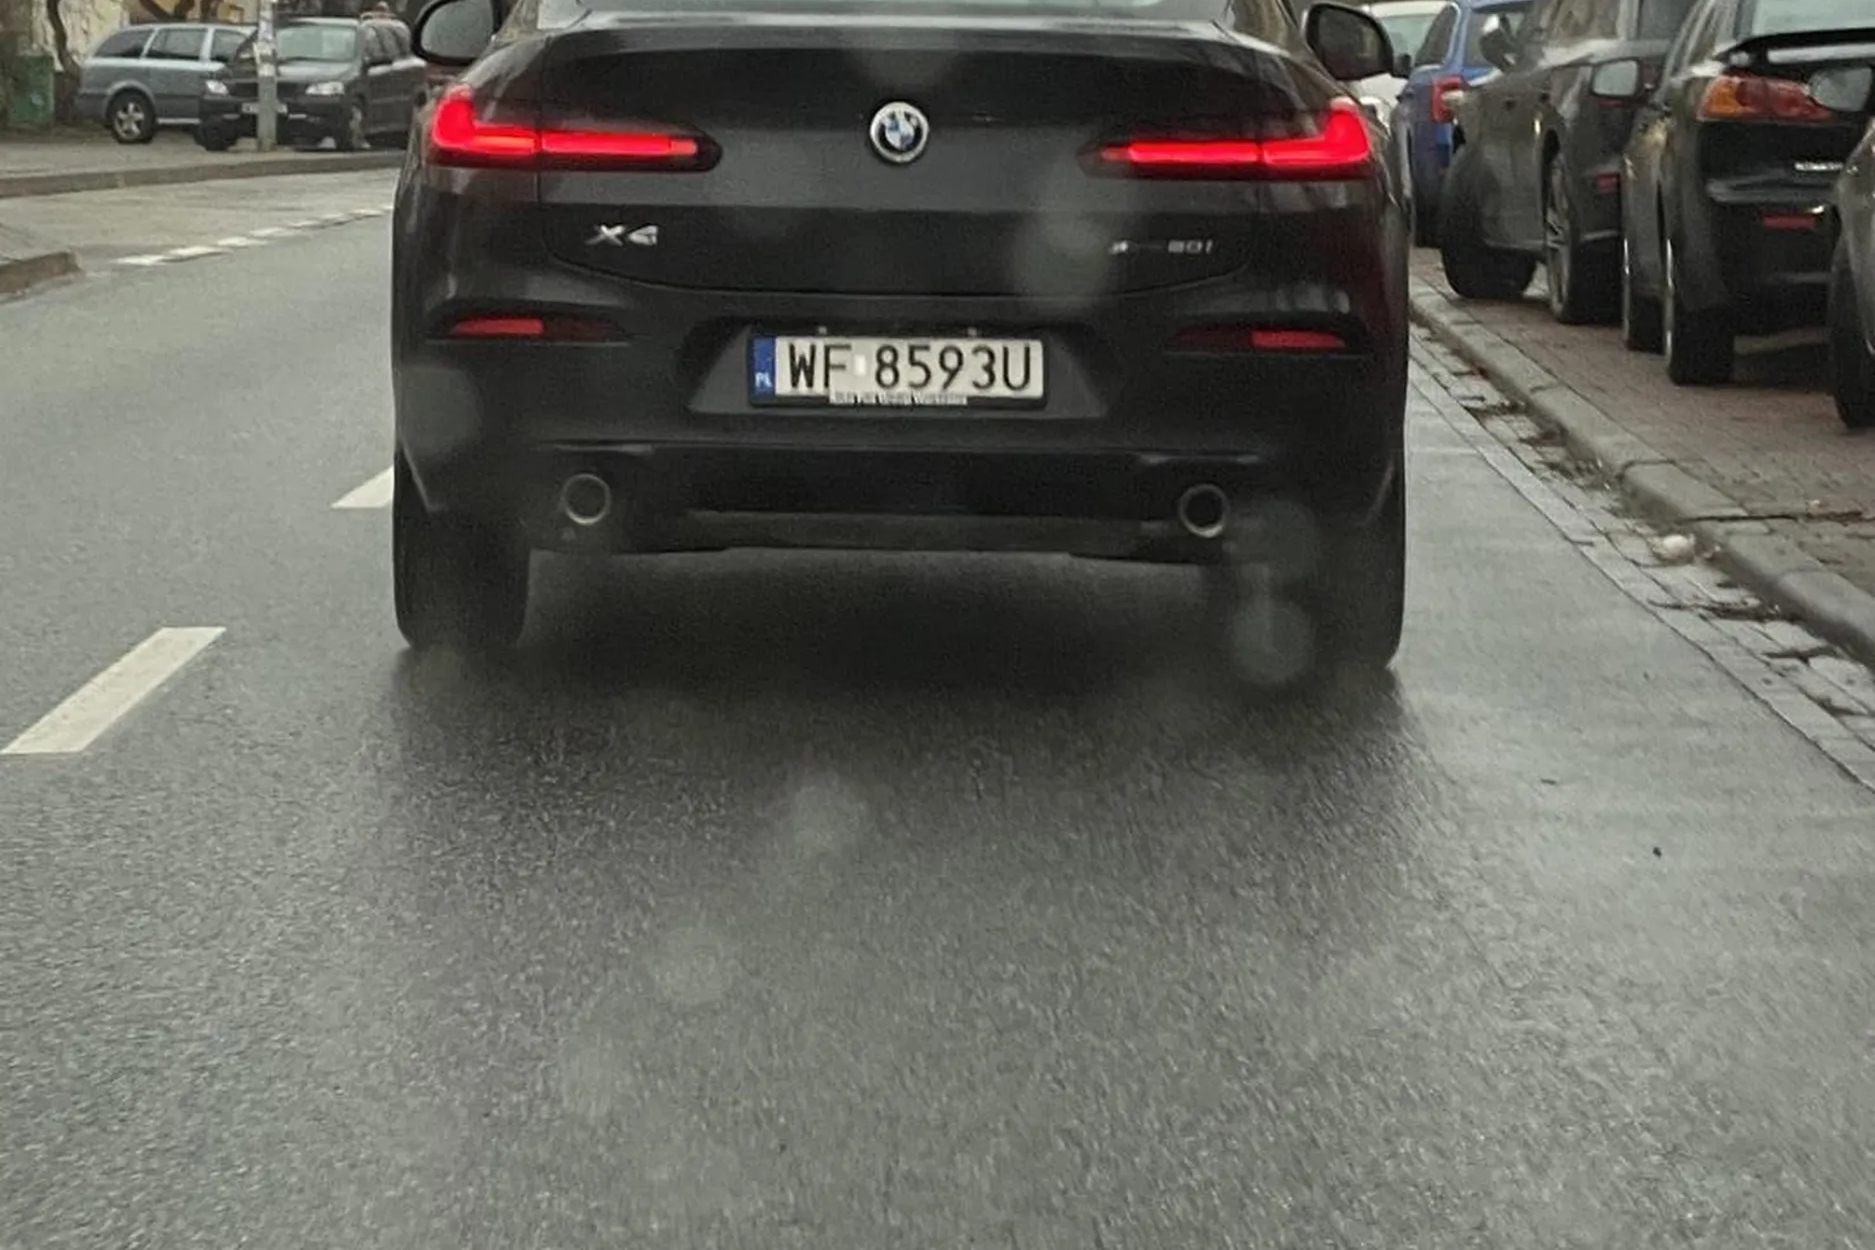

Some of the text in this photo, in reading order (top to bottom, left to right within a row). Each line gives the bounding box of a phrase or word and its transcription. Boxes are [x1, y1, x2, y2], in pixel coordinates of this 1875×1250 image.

[584, 224, 659, 247] X4
[789, 342, 1031, 391] WF 8593U
